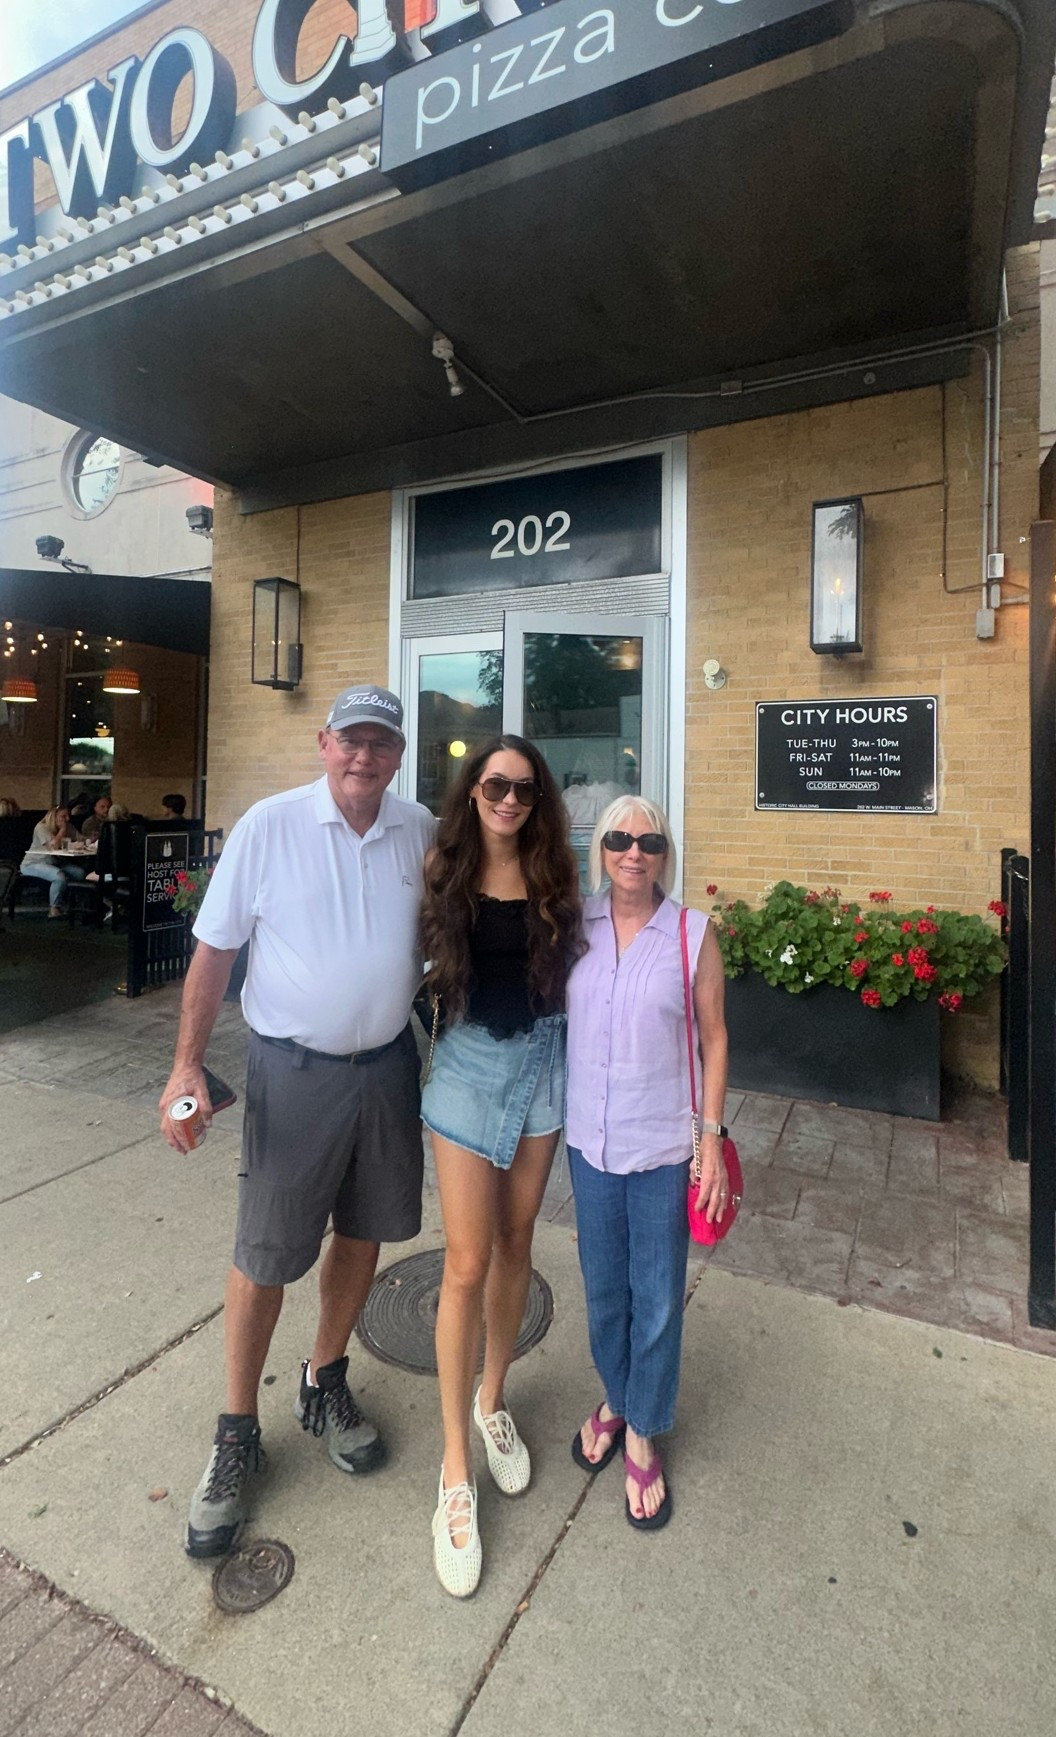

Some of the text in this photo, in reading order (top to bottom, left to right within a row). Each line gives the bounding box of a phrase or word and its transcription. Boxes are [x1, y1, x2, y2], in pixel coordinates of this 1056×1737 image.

[415, 8, 616, 150] pizza
[490, 510, 571, 560] 202
[781, 706, 908, 726] CITY HOURS
[786, 739, 837, 748] TUE-THU
[789, 753, 833, 762] FRI-SAT
[799, 767, 823, 776] SUN
[808, 782, 877, 791] CLOSED MONDAYS
[147, 860, 185, 870] PLEASE SEE
[147, 870, 168, 878] HOST
